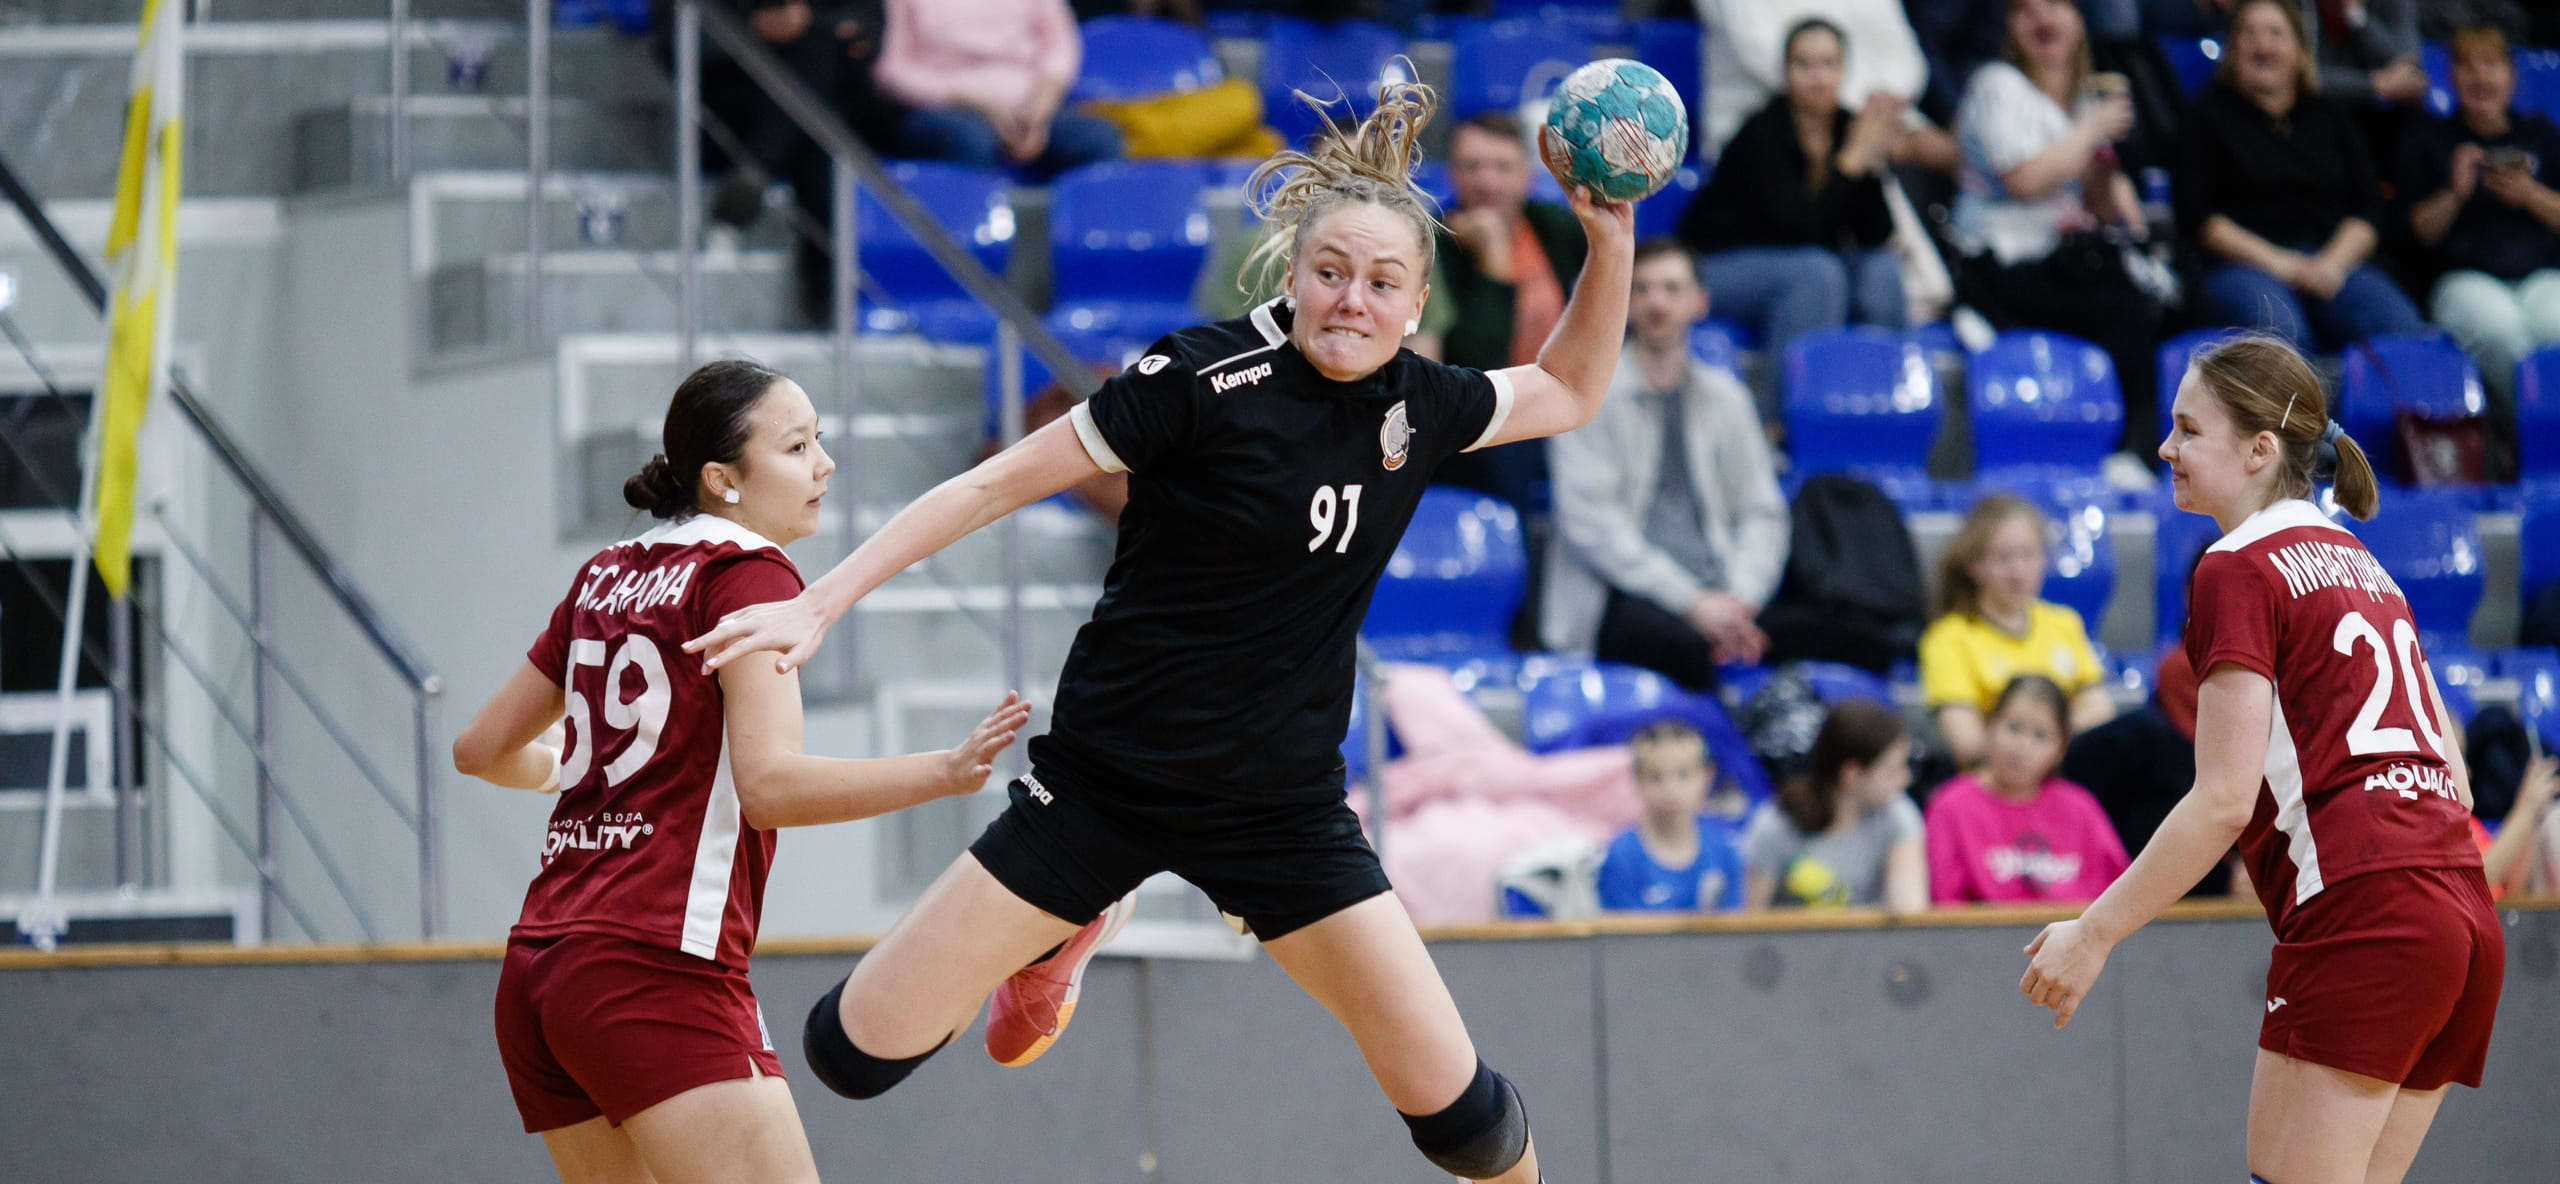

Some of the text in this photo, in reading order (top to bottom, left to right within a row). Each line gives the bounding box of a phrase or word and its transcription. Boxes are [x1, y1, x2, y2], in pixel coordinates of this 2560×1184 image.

[1210, 362, 1273, 394] Kempa
[1308, 484, 1363, 554] 91
[2333, 611, 2447, 760] 20
[560, 633, 672, 791] 59
[1019, 773, 1055, 806] empa
[2364, 765, 2458, 801] AQUALIT
[602, 811, 644, 824] ВОДА
